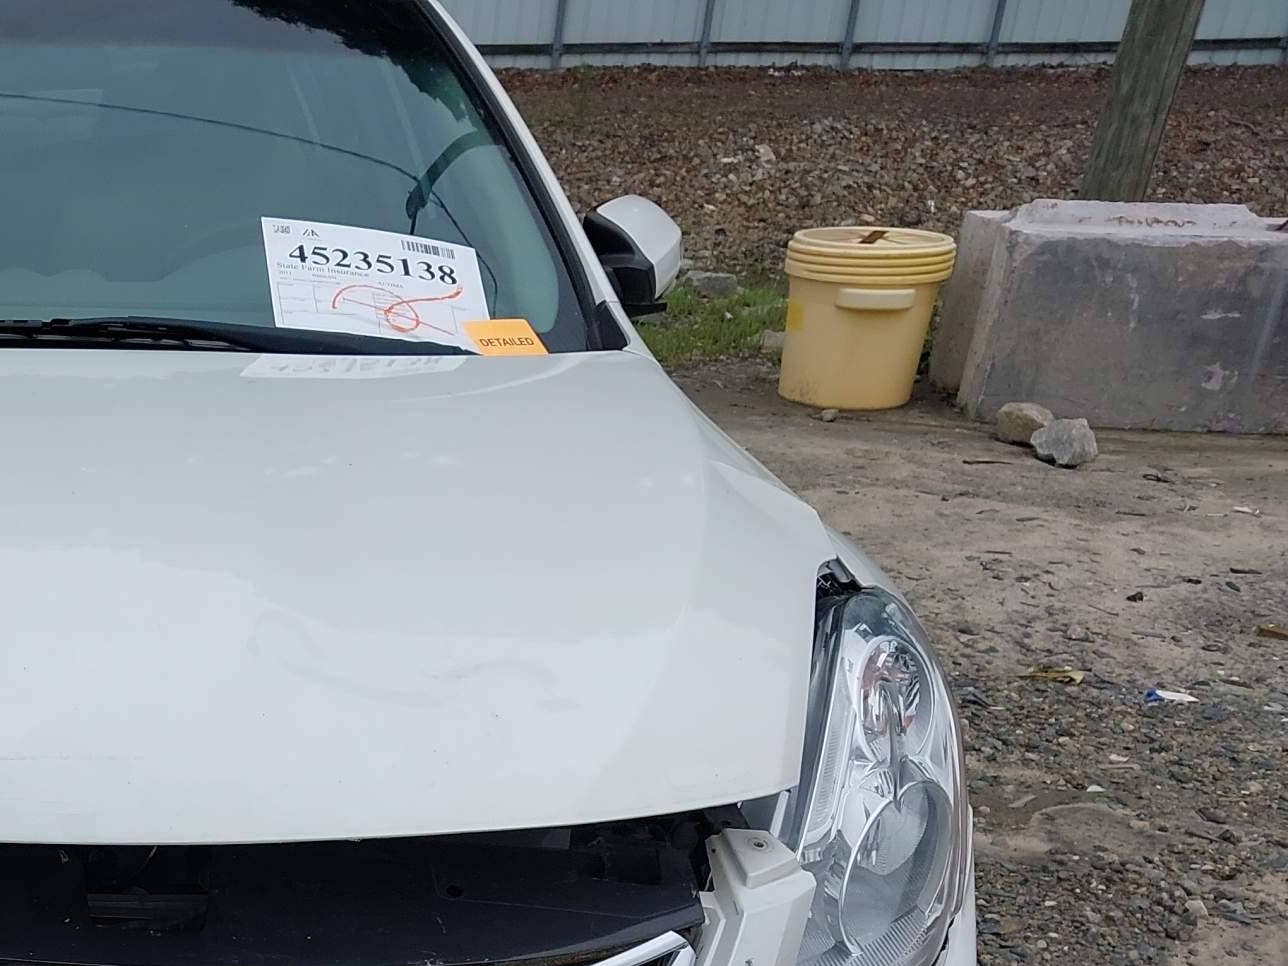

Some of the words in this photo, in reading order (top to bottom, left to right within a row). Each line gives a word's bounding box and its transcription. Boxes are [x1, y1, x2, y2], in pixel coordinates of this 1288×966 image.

[277, 261, 298, 270] State
[301, 264, 325, 273] Farm
[327, 266, 369, 278] Insurance
[289, 244, 458, 285] 45235138
[479, 337, 535, 347] DETAILED
